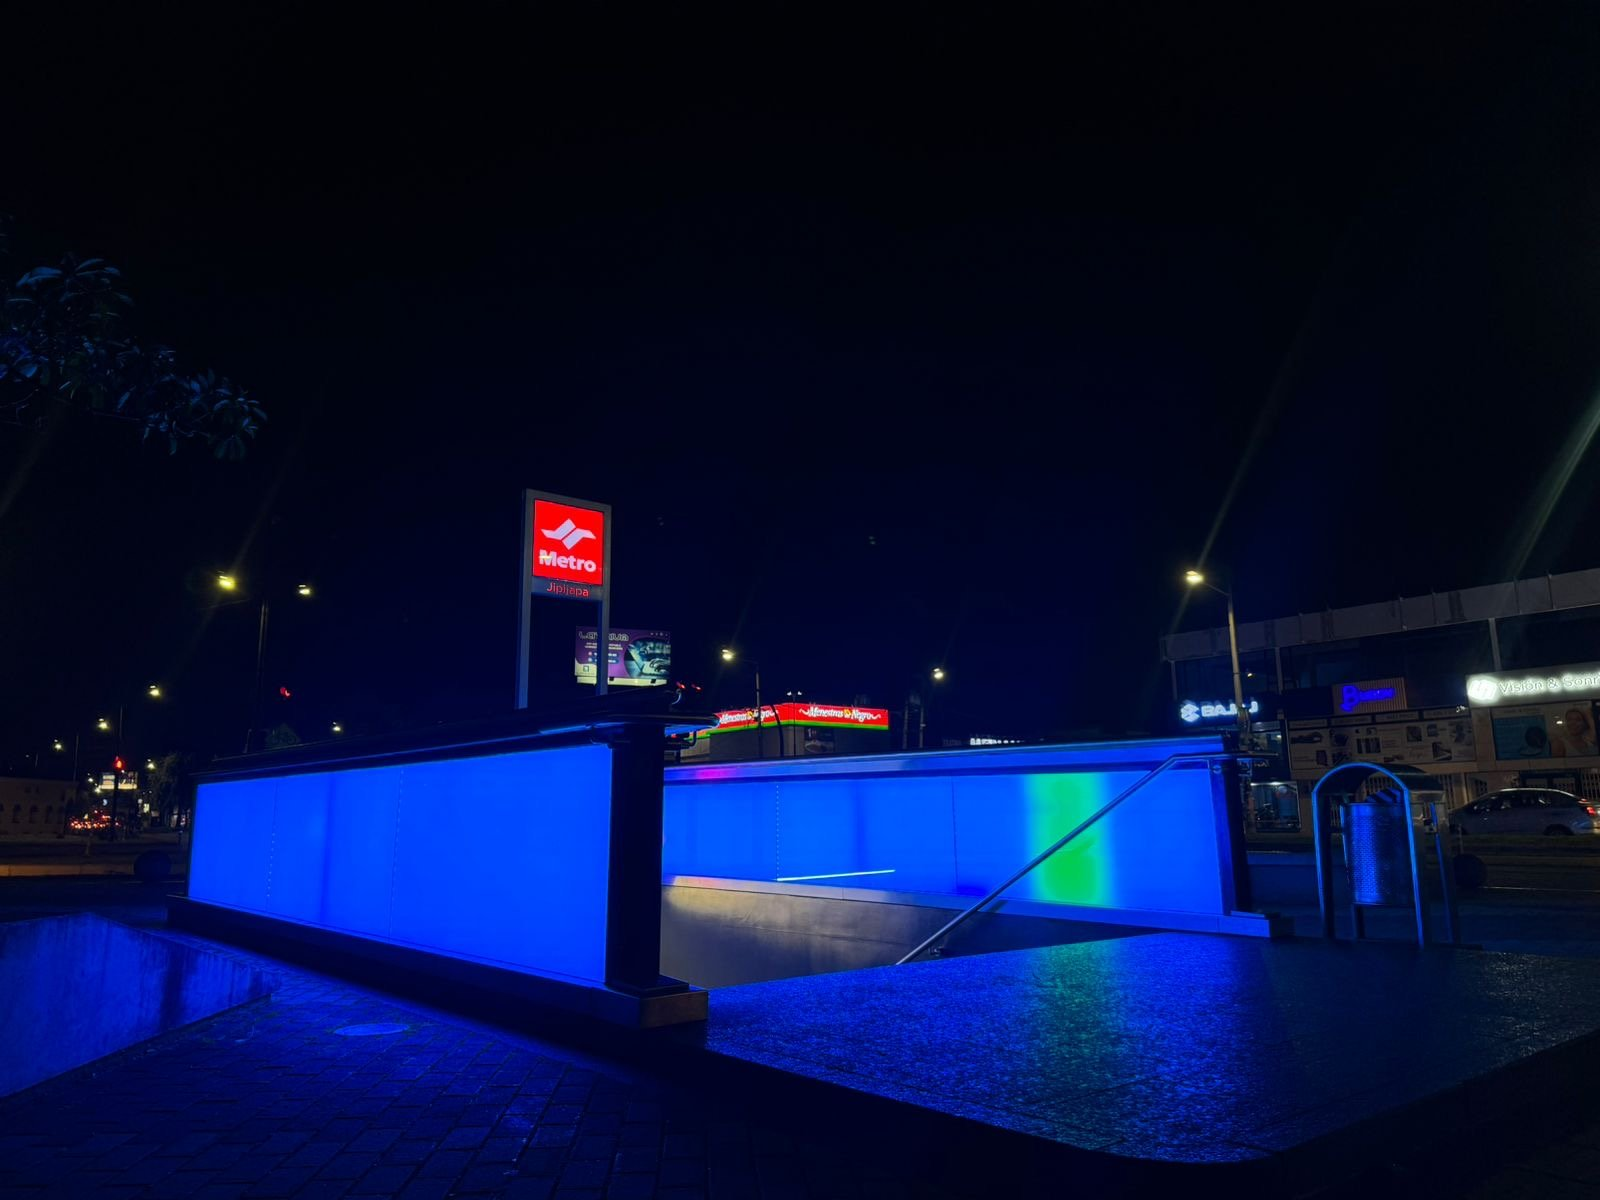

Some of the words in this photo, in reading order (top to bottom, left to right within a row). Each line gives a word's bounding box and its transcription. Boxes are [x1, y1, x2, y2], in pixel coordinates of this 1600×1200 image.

[538, 549, 597, 573] Metro
[546, 582, 589, 598] Jipijapa
[1547, 678, 1558, 690] &
[1201, 701, 1258, 717] BAJJ
